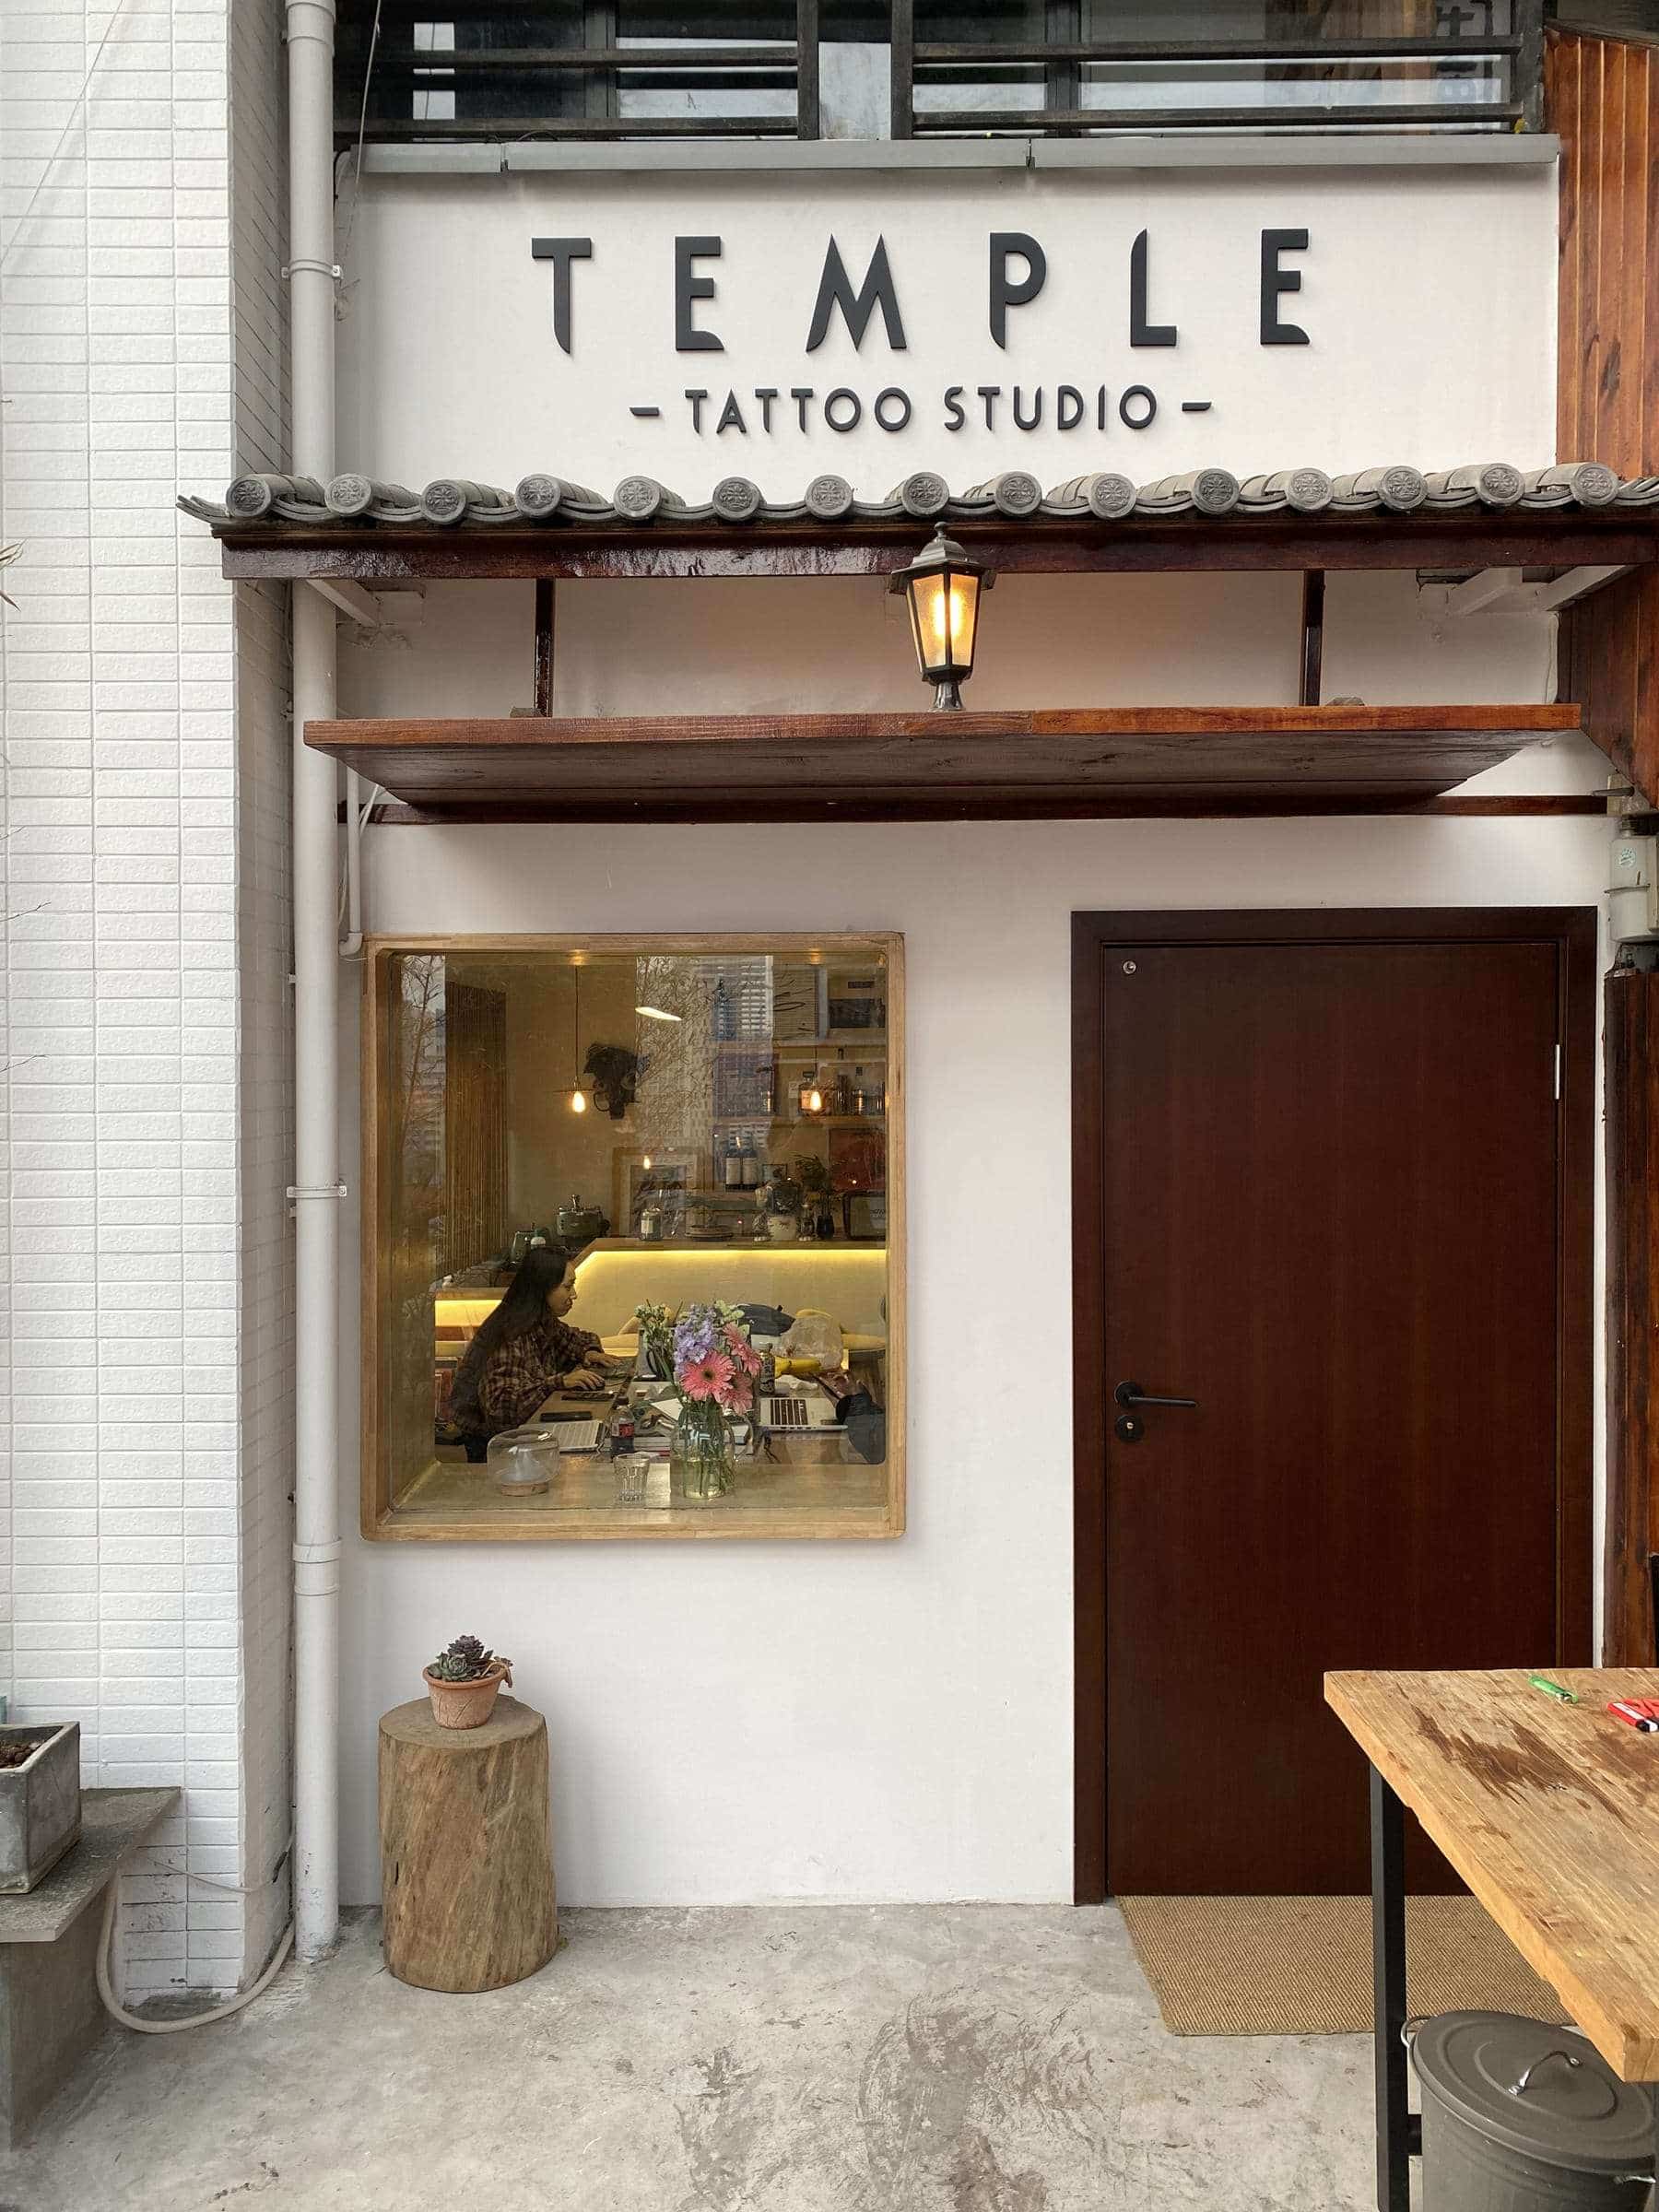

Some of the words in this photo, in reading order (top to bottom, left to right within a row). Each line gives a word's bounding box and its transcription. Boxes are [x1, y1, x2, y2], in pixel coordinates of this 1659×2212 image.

[531, 228, 1311, 355] TEMPLE
[684, 387, 912, 435] TATTOO
[944, 384, 1158, 432] STUDIO
